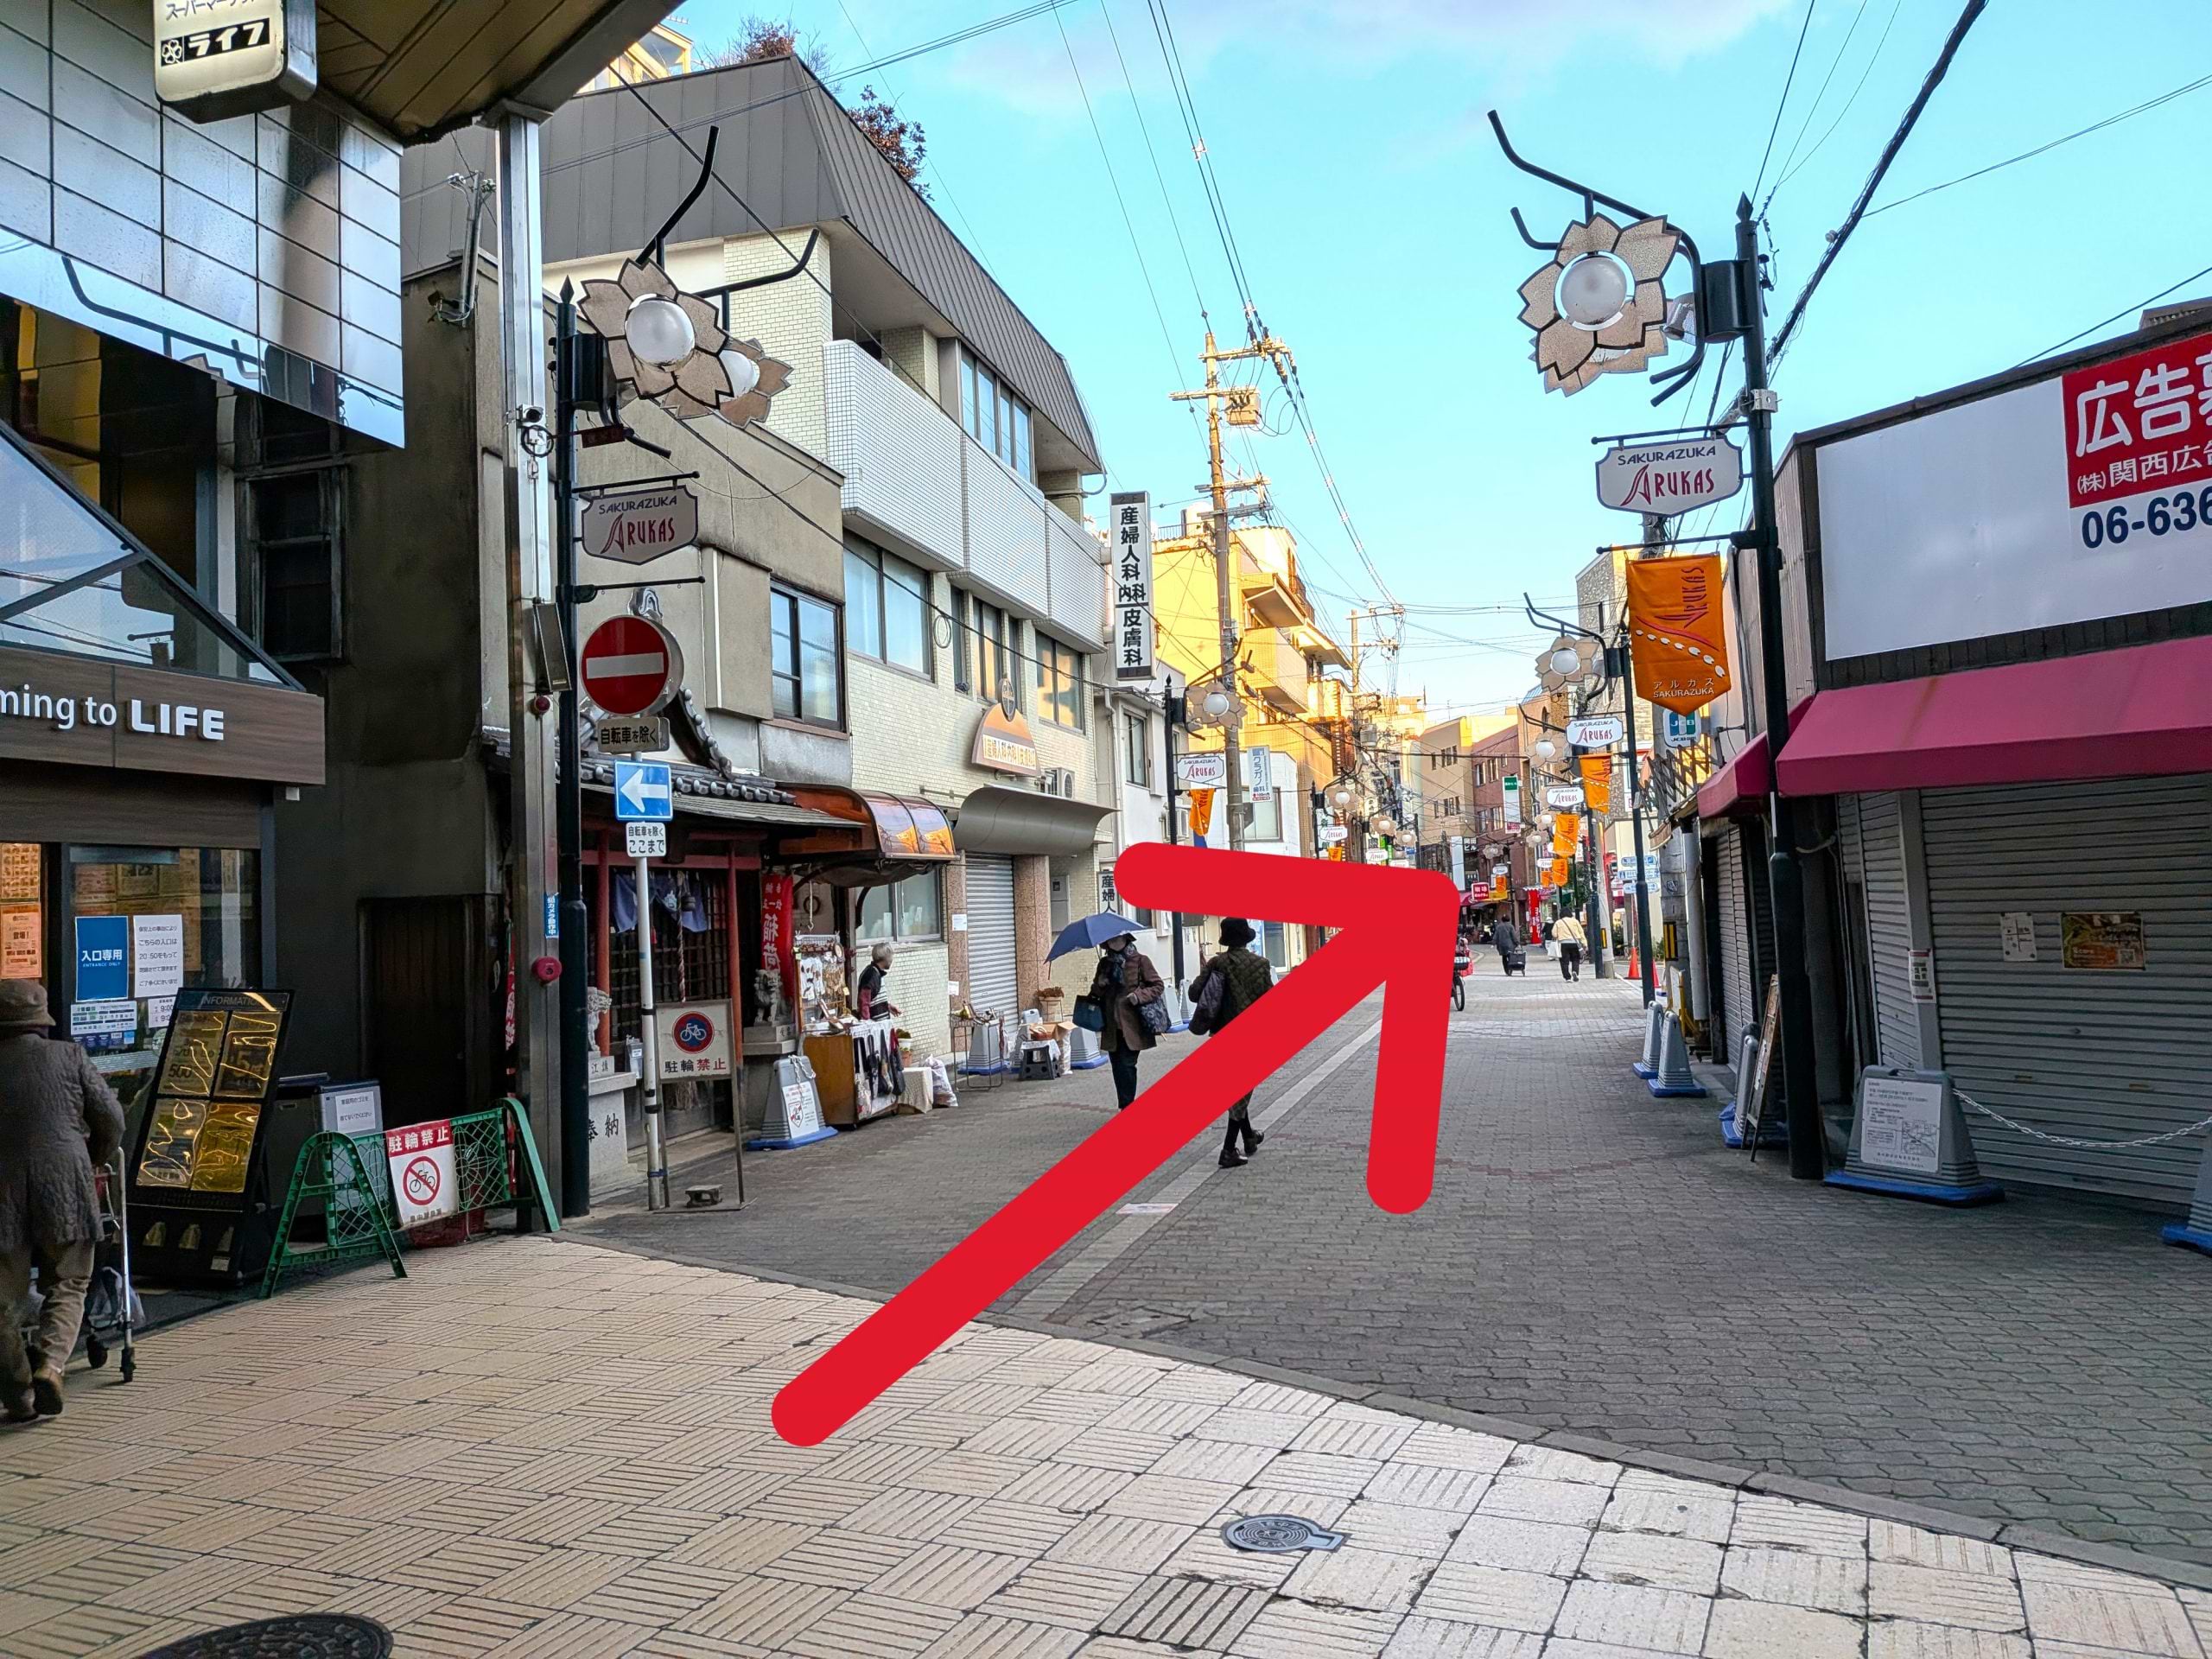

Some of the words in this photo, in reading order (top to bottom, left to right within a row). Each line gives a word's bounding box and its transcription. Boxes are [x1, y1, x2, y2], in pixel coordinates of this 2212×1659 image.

[166, 0, 257, 21] スーパーマー
[188, 22, 264, 57] ライフ
[2075, 348, 2212, 458] 広告
[1618, 446, 1716, 466] SAKURAZUKA
[1620, 463, 1715, 506] ARUKAS
[599, 495, 677, 515] SAKURAZUKA
[600, 512, 676, 555] ARUKAS
[1120, 505, 1141, 582] 産婦人科
[1655, 566, 1709, 629] ARUKAS
[1122, 607, 1143, 667] 皮膚科
[1653, 687, 1715, 699] SAKURAZUKA
[85, 696, 118, 726] to
[130, 698, 225, 741] LIFE
[601, 725, 658, 746] 自転車を除く
[1575, 727, 1613, 744] ARUKAS
[628, 825, 664, 837] 自転車を除く
[628, 839, 665, 854] ここまで
[81, 949, 123, 962] 入口専用
[204, 995, 263, 1007] INFORMATIO
[664, 1058, 727, 1074] 駐輪禁止
[388, 1126, 450, 1154] 駐輪禁止
